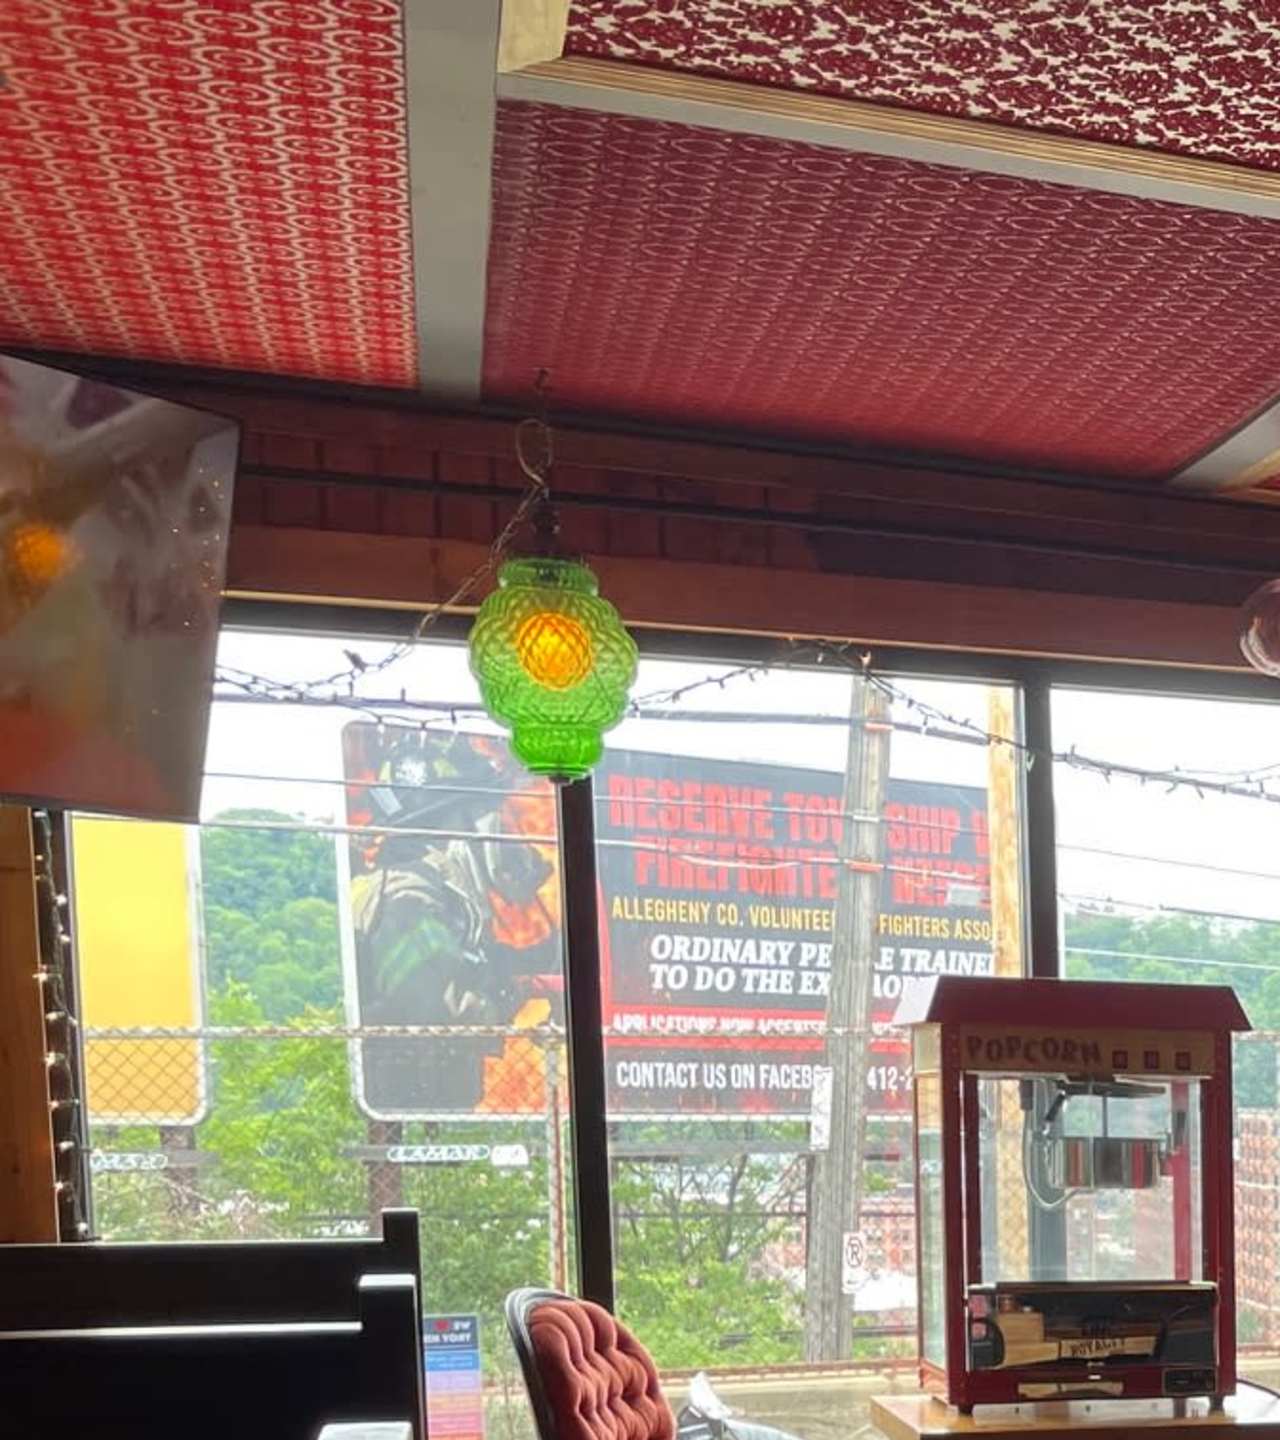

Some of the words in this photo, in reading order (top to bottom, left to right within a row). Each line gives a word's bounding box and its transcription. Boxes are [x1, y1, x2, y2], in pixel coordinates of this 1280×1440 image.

[608, 774, 774, 840] RESERVE
[784, 791, 961, 856] TOSHIP
[635, 834, 842, 899] FIREFIGHTE
[612, 896, 711, 924] ALLEGHENY
[716, 903, 744, 927] CO.
[954, 918, 991, 941] ASSO
[651, 934, 796, 967] ORDINARY
[899, 947, 993, 976] TRAINE
[649, 963, 688, 990] TO
[694, 965, 736, 991] DO
[741, 968, 795, 994] THE
[966, 1036, 1102, 1063] POPCORN
[616, 1061, 699, 1089] CONTACT
[702, 1063, 727, 1088] US
[730, 1065, 754, 1089] ON
